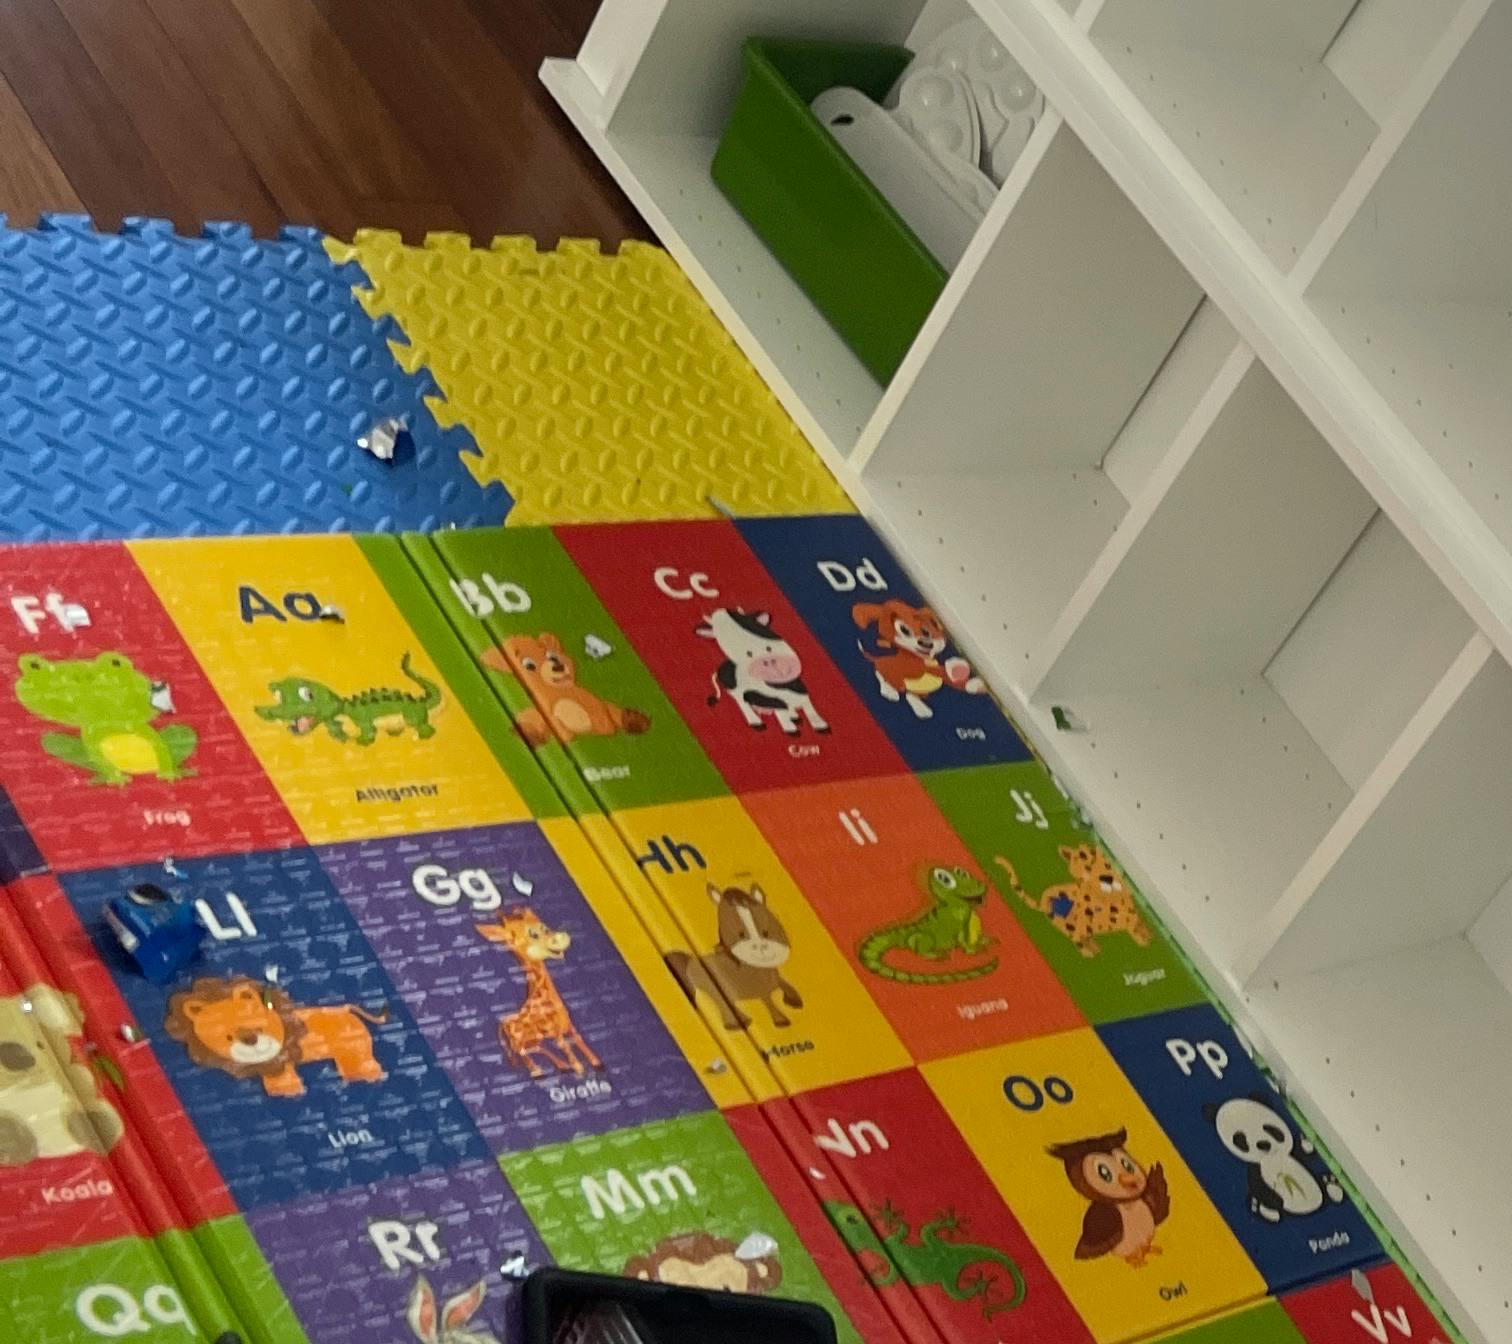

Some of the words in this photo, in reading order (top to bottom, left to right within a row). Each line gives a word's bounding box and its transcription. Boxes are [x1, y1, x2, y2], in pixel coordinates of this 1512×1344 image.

[654, 566, 720, 600] Cc
[817, 558, 888, 593] Dd
[448, 572, 533, 619] Bb
[955, 726, 987, 742] Dog
[583, 763, 632, 782] Bear
[354, 780, 440, 804] Alligator
[142, 807, 191, 830] Frog
[1010, 789, 1049, 830] Jj
[412, 863, 502, 911] Gg
[956, 996, 1010, 1020] Iguana
[1165, 1036, 1230, 1080] Pp
[548, 1076, 612, 1104] Giraffe
[1002, 1074, 1075, 1114] Oo
[327, 1127, 375, 1150] Lion
[40, 1177, 114, 1204] Koala
[578, 1162, 697, 1220] Mm
[367, 1219, 441, 1270] Rr
[1307, 1229, 1351, 1256] Panda
[1158, 1281, 1189, 1303] Owl
[74, 1283, 197, 1337] Qq
